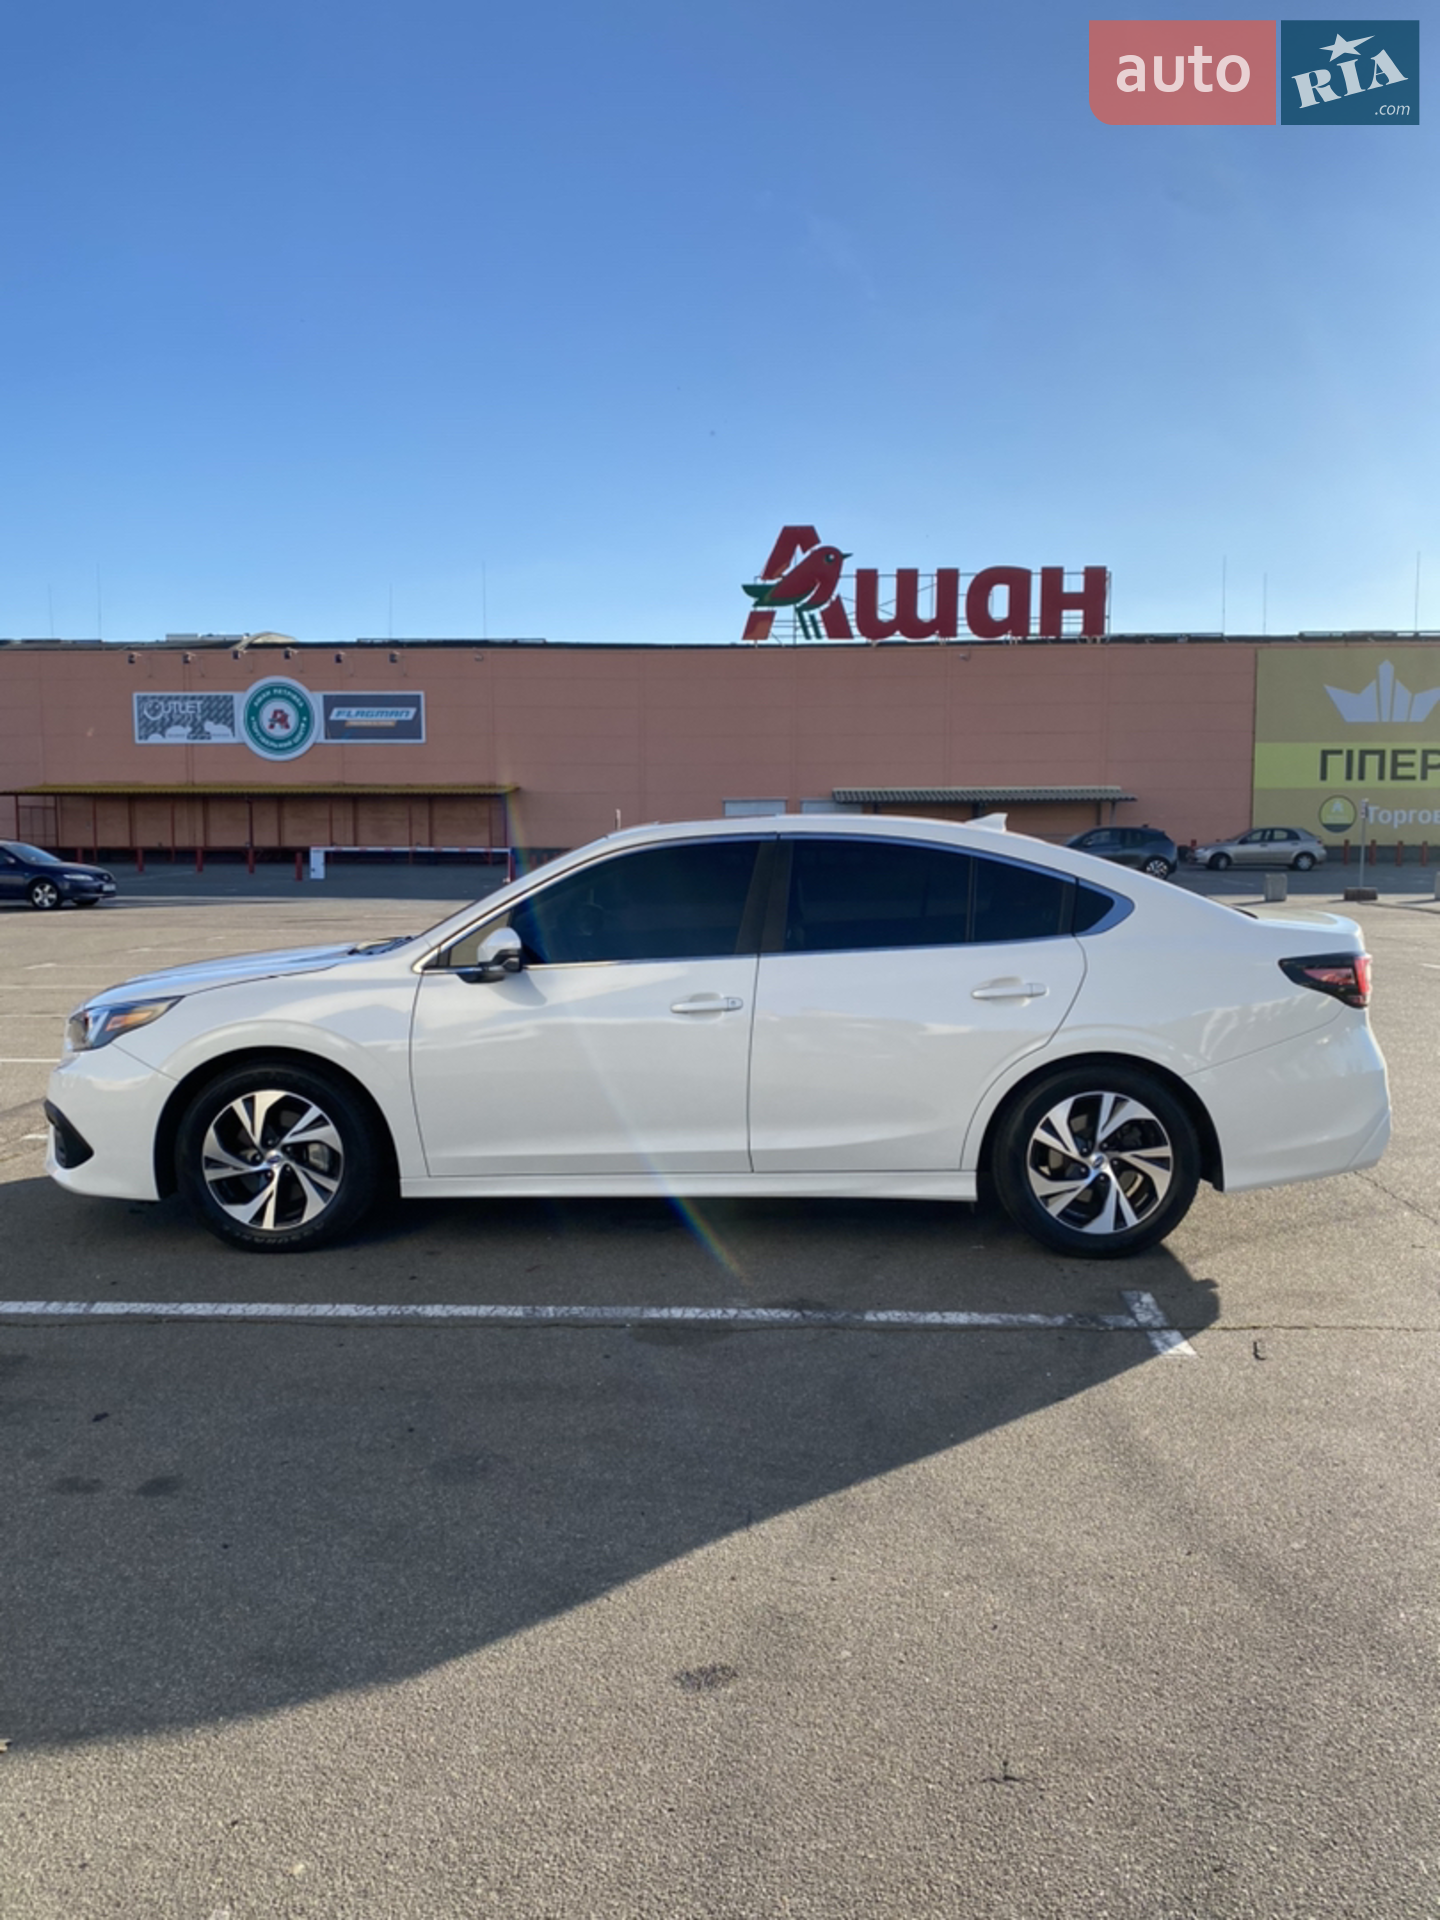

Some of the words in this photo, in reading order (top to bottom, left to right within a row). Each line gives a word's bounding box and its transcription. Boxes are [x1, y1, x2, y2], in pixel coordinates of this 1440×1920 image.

[741, 525, 1108, 640] Ашан
[143, 700, 203, 721] OUTLET
[334, 709, 411, 719] FLAGMAN
[1320, 749, 1440, 781] ГІПЕР
